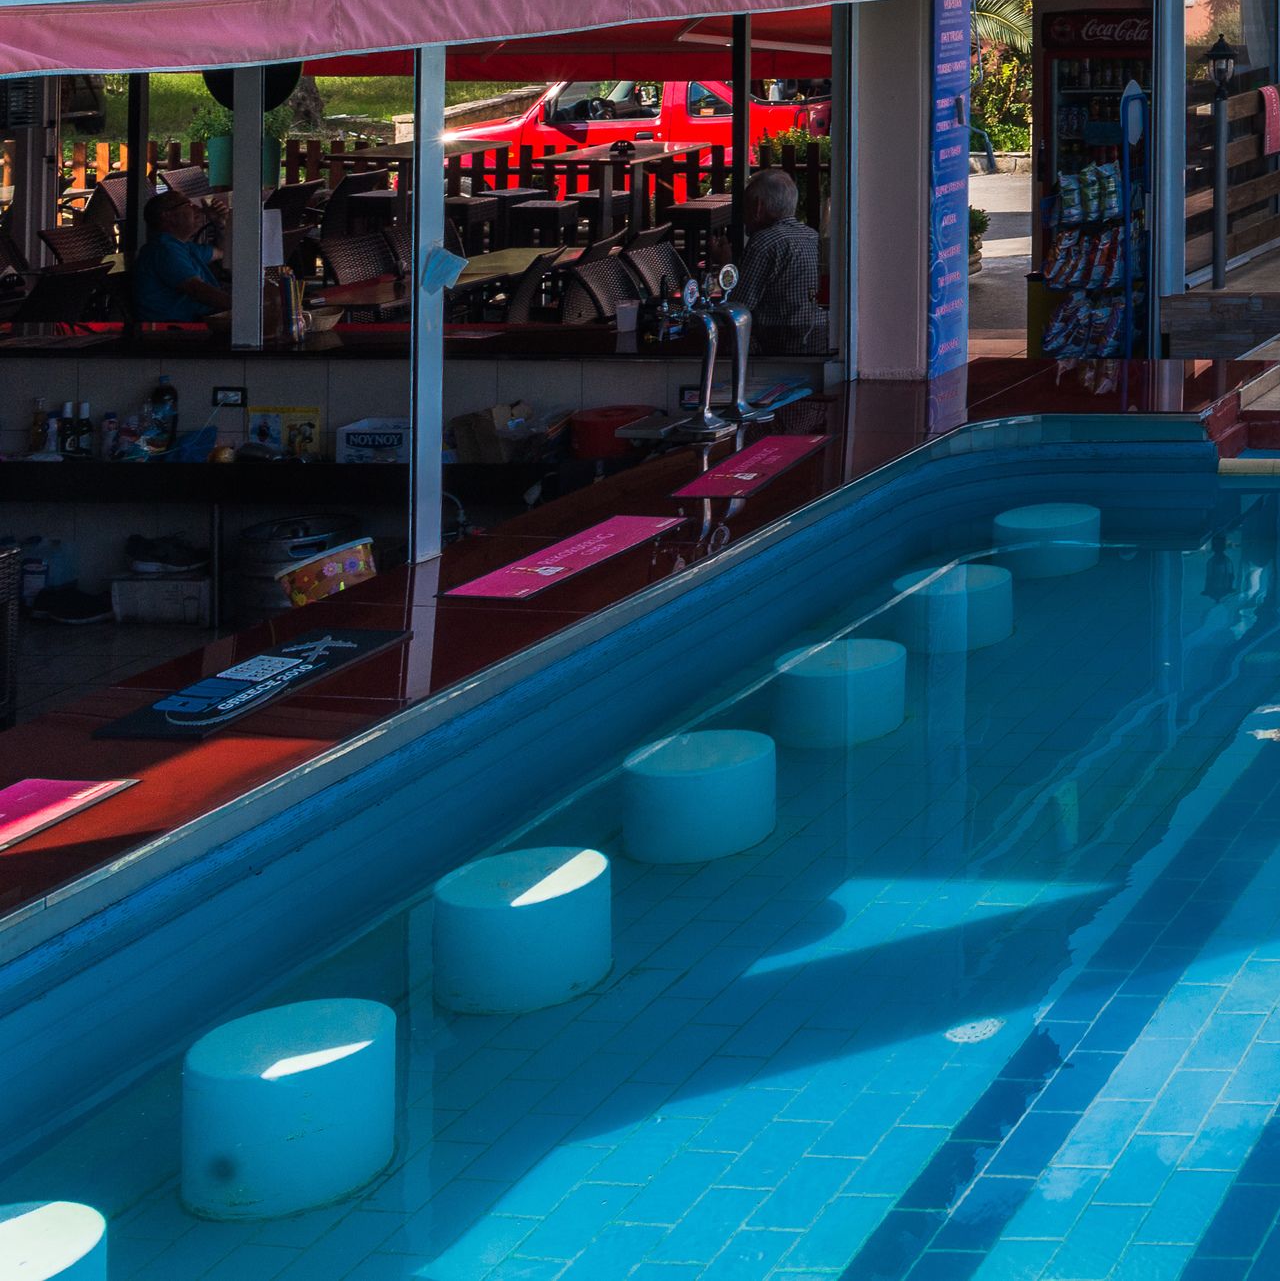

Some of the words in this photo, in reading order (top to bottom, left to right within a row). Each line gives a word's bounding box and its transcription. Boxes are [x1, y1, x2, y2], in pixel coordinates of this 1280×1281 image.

[1081, 19, 1151, 41] Coca-Cola
[348, 433, 402, 446] NOYNOY
[217, 678, 282, 711] GREECE
[279, 664, 313, 684] 2010
